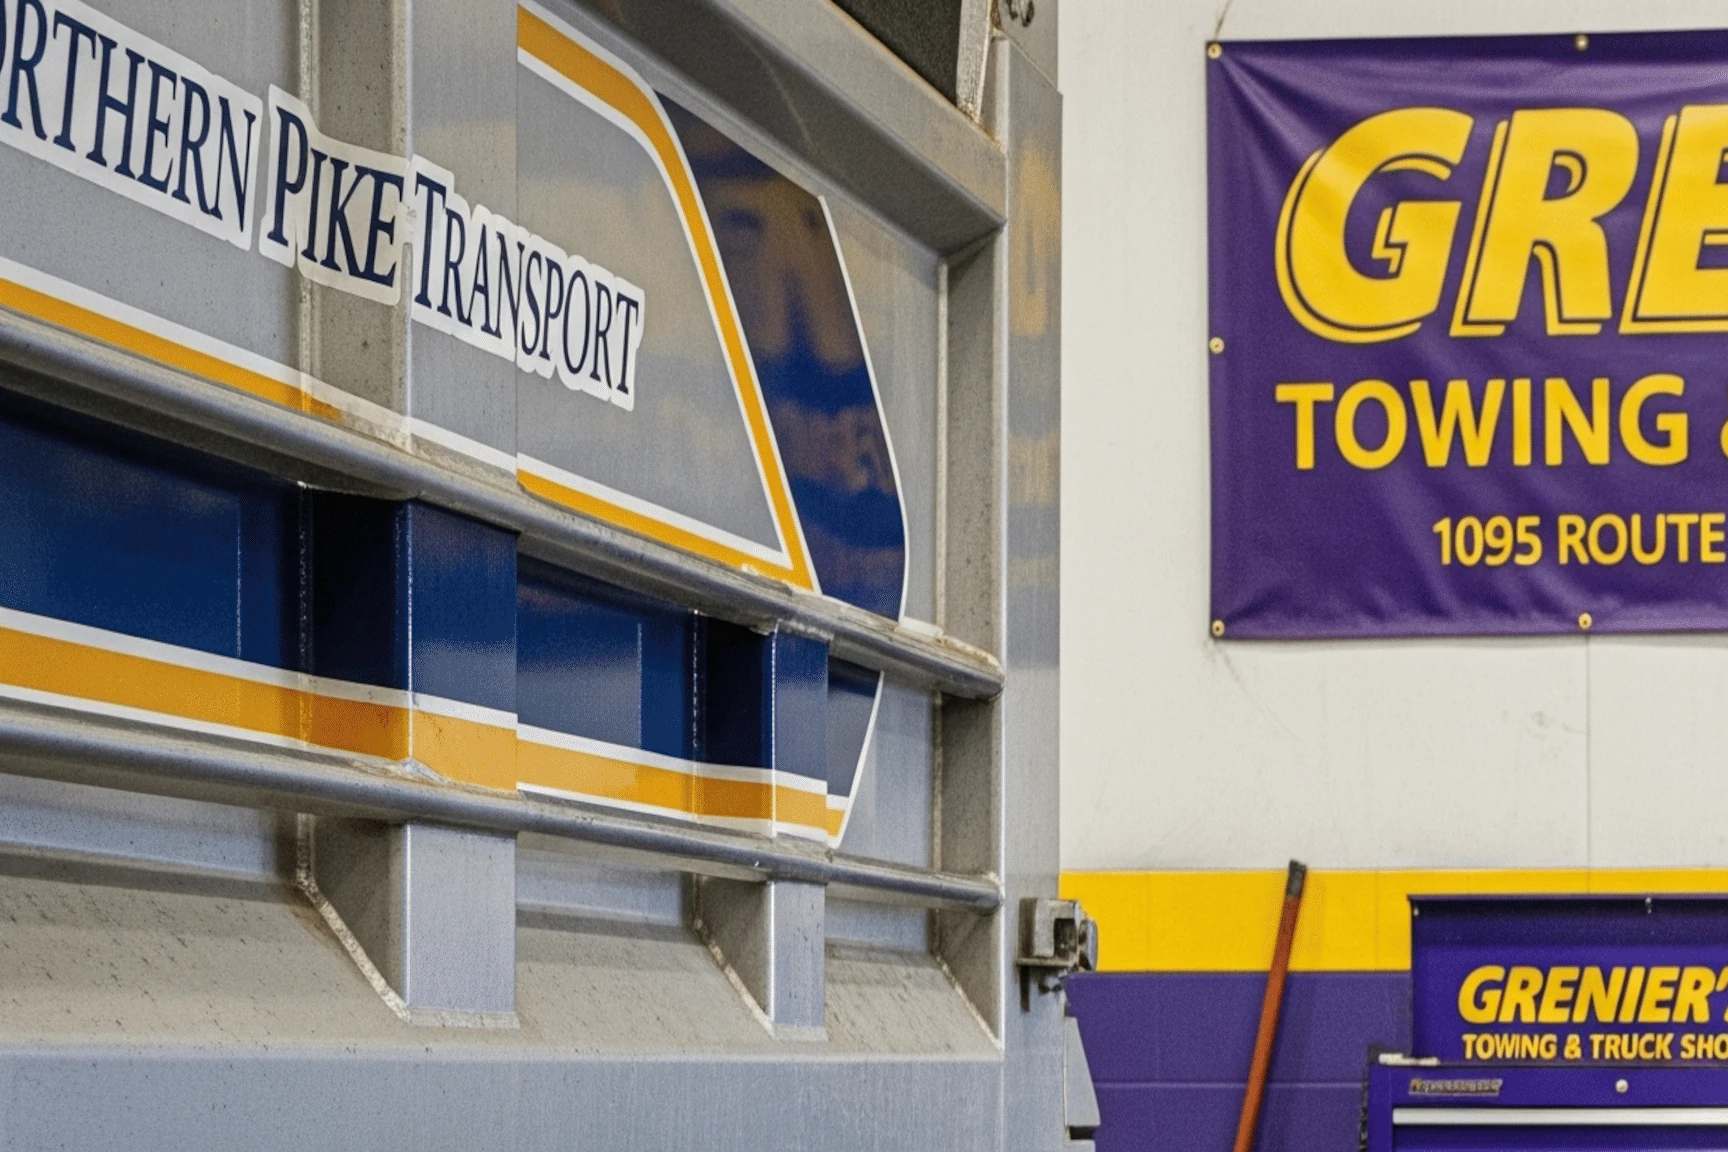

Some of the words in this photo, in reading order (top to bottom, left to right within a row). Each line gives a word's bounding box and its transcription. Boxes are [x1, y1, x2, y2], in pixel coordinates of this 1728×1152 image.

[0, 0, 256, 233] RTHERN
[267, 105, 405, 288] PIKE
[414, 171, 640, 395] TRANSPORT
[1276, 373, 1689, 469] TOWING
[1433, 516, 1542, 565] 1095
[1558, 513, 1726, 564] ROUTE
[1462, 1033, 1557, 1060] TOWING
[1564, 1034, 1581, 1060] &
[1591, 1033, 1673, 1060] TRUCK
